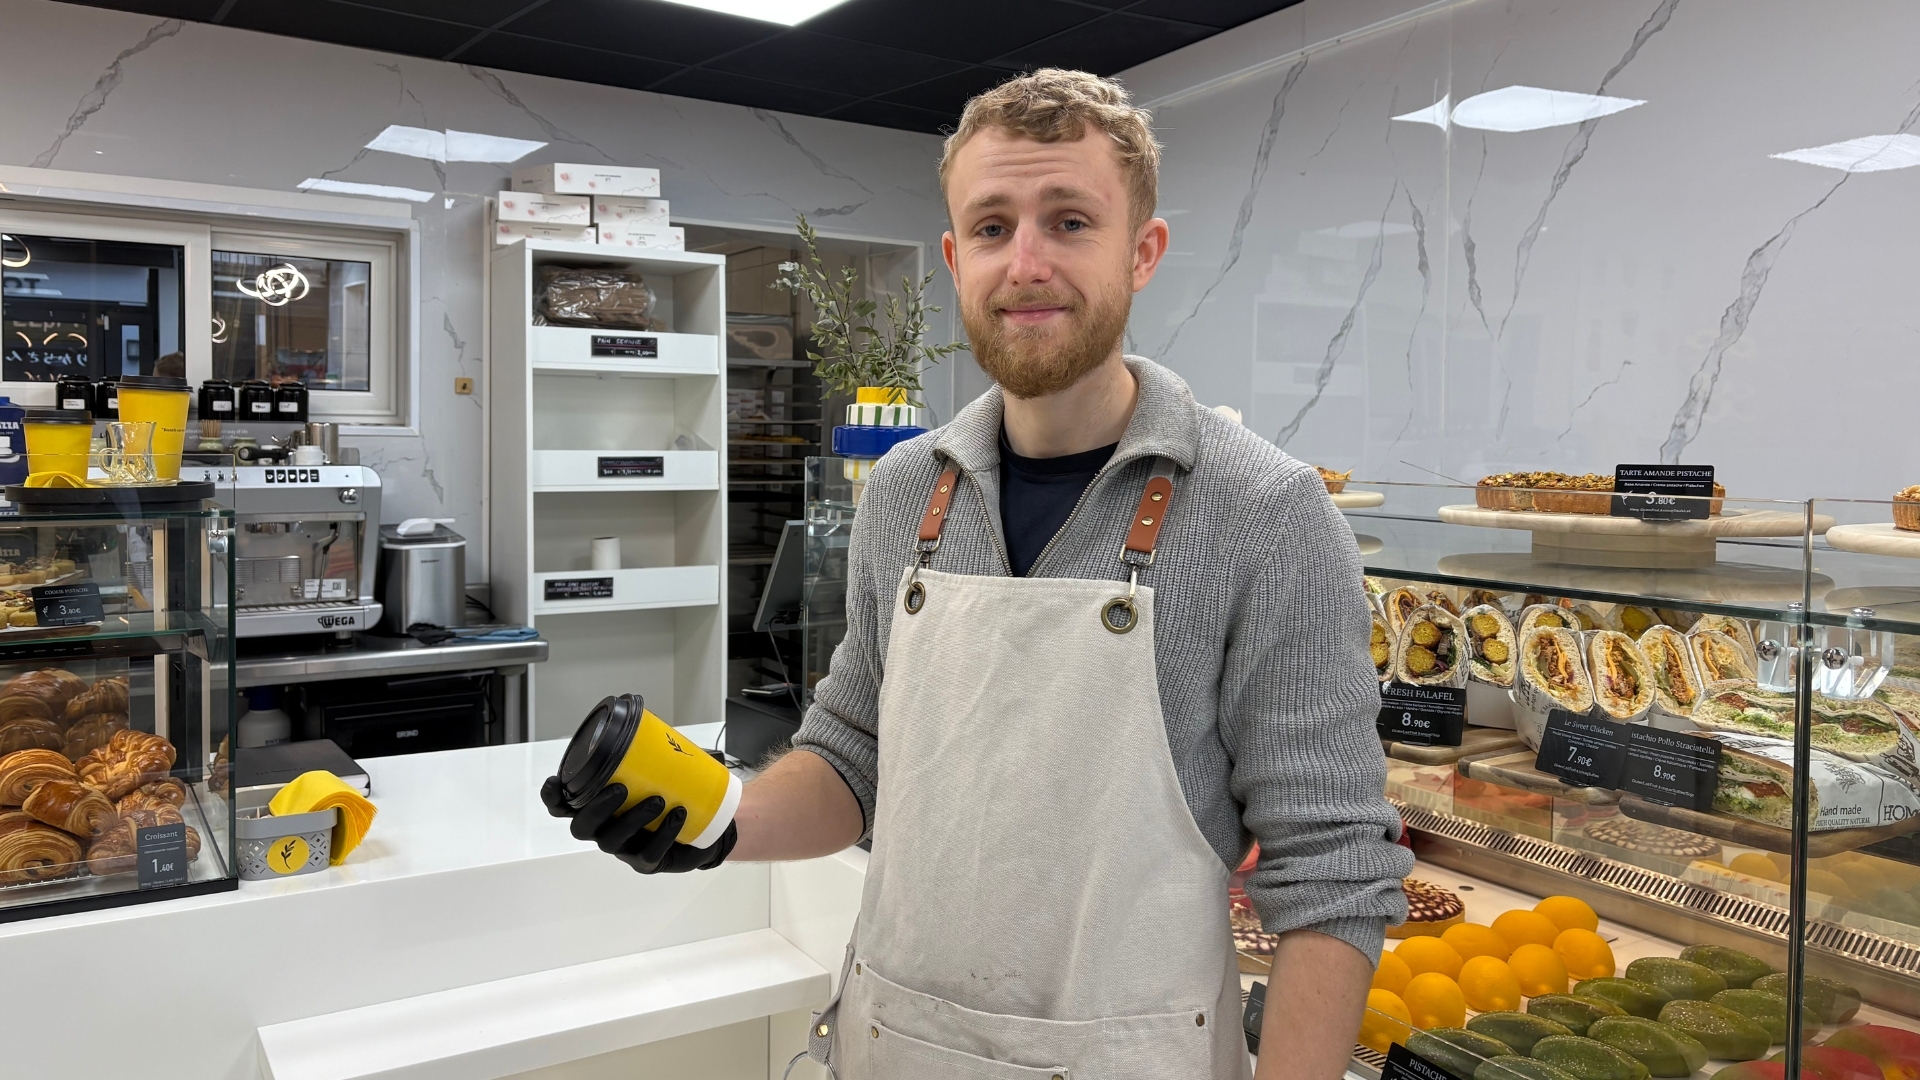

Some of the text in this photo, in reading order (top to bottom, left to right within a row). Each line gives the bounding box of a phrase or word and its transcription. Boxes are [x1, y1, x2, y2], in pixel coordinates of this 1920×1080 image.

[0, 422, 20, 430] ZZA
[318, 615, 355, 628] WEGA
[1385, 687, 1455, 701] FRESH FALAFEL
[1402, 712, 1431, 729] 8.90€
[1564, 718, 1572, 727] Le
[1572, 720, 1589, 731] Sweet
[1589, 724, 1614, 737] Chicken
[1631, 731, 1715, 755] istachio Pollo Straciatella
[1567, 745, 1593, 767] 7.90€
[1653, 764, 1677, 782] 8.90€
[1820, 804, 1862, 817] Hand made
[1815, 817, 1871, 827] HIGH QUALITY NATURAL
[144, 831, 178, 841] Croissant
[152, 858, 174, 874] 1.40€
[1408, 1058, 1447, 1080] PISTACHE
